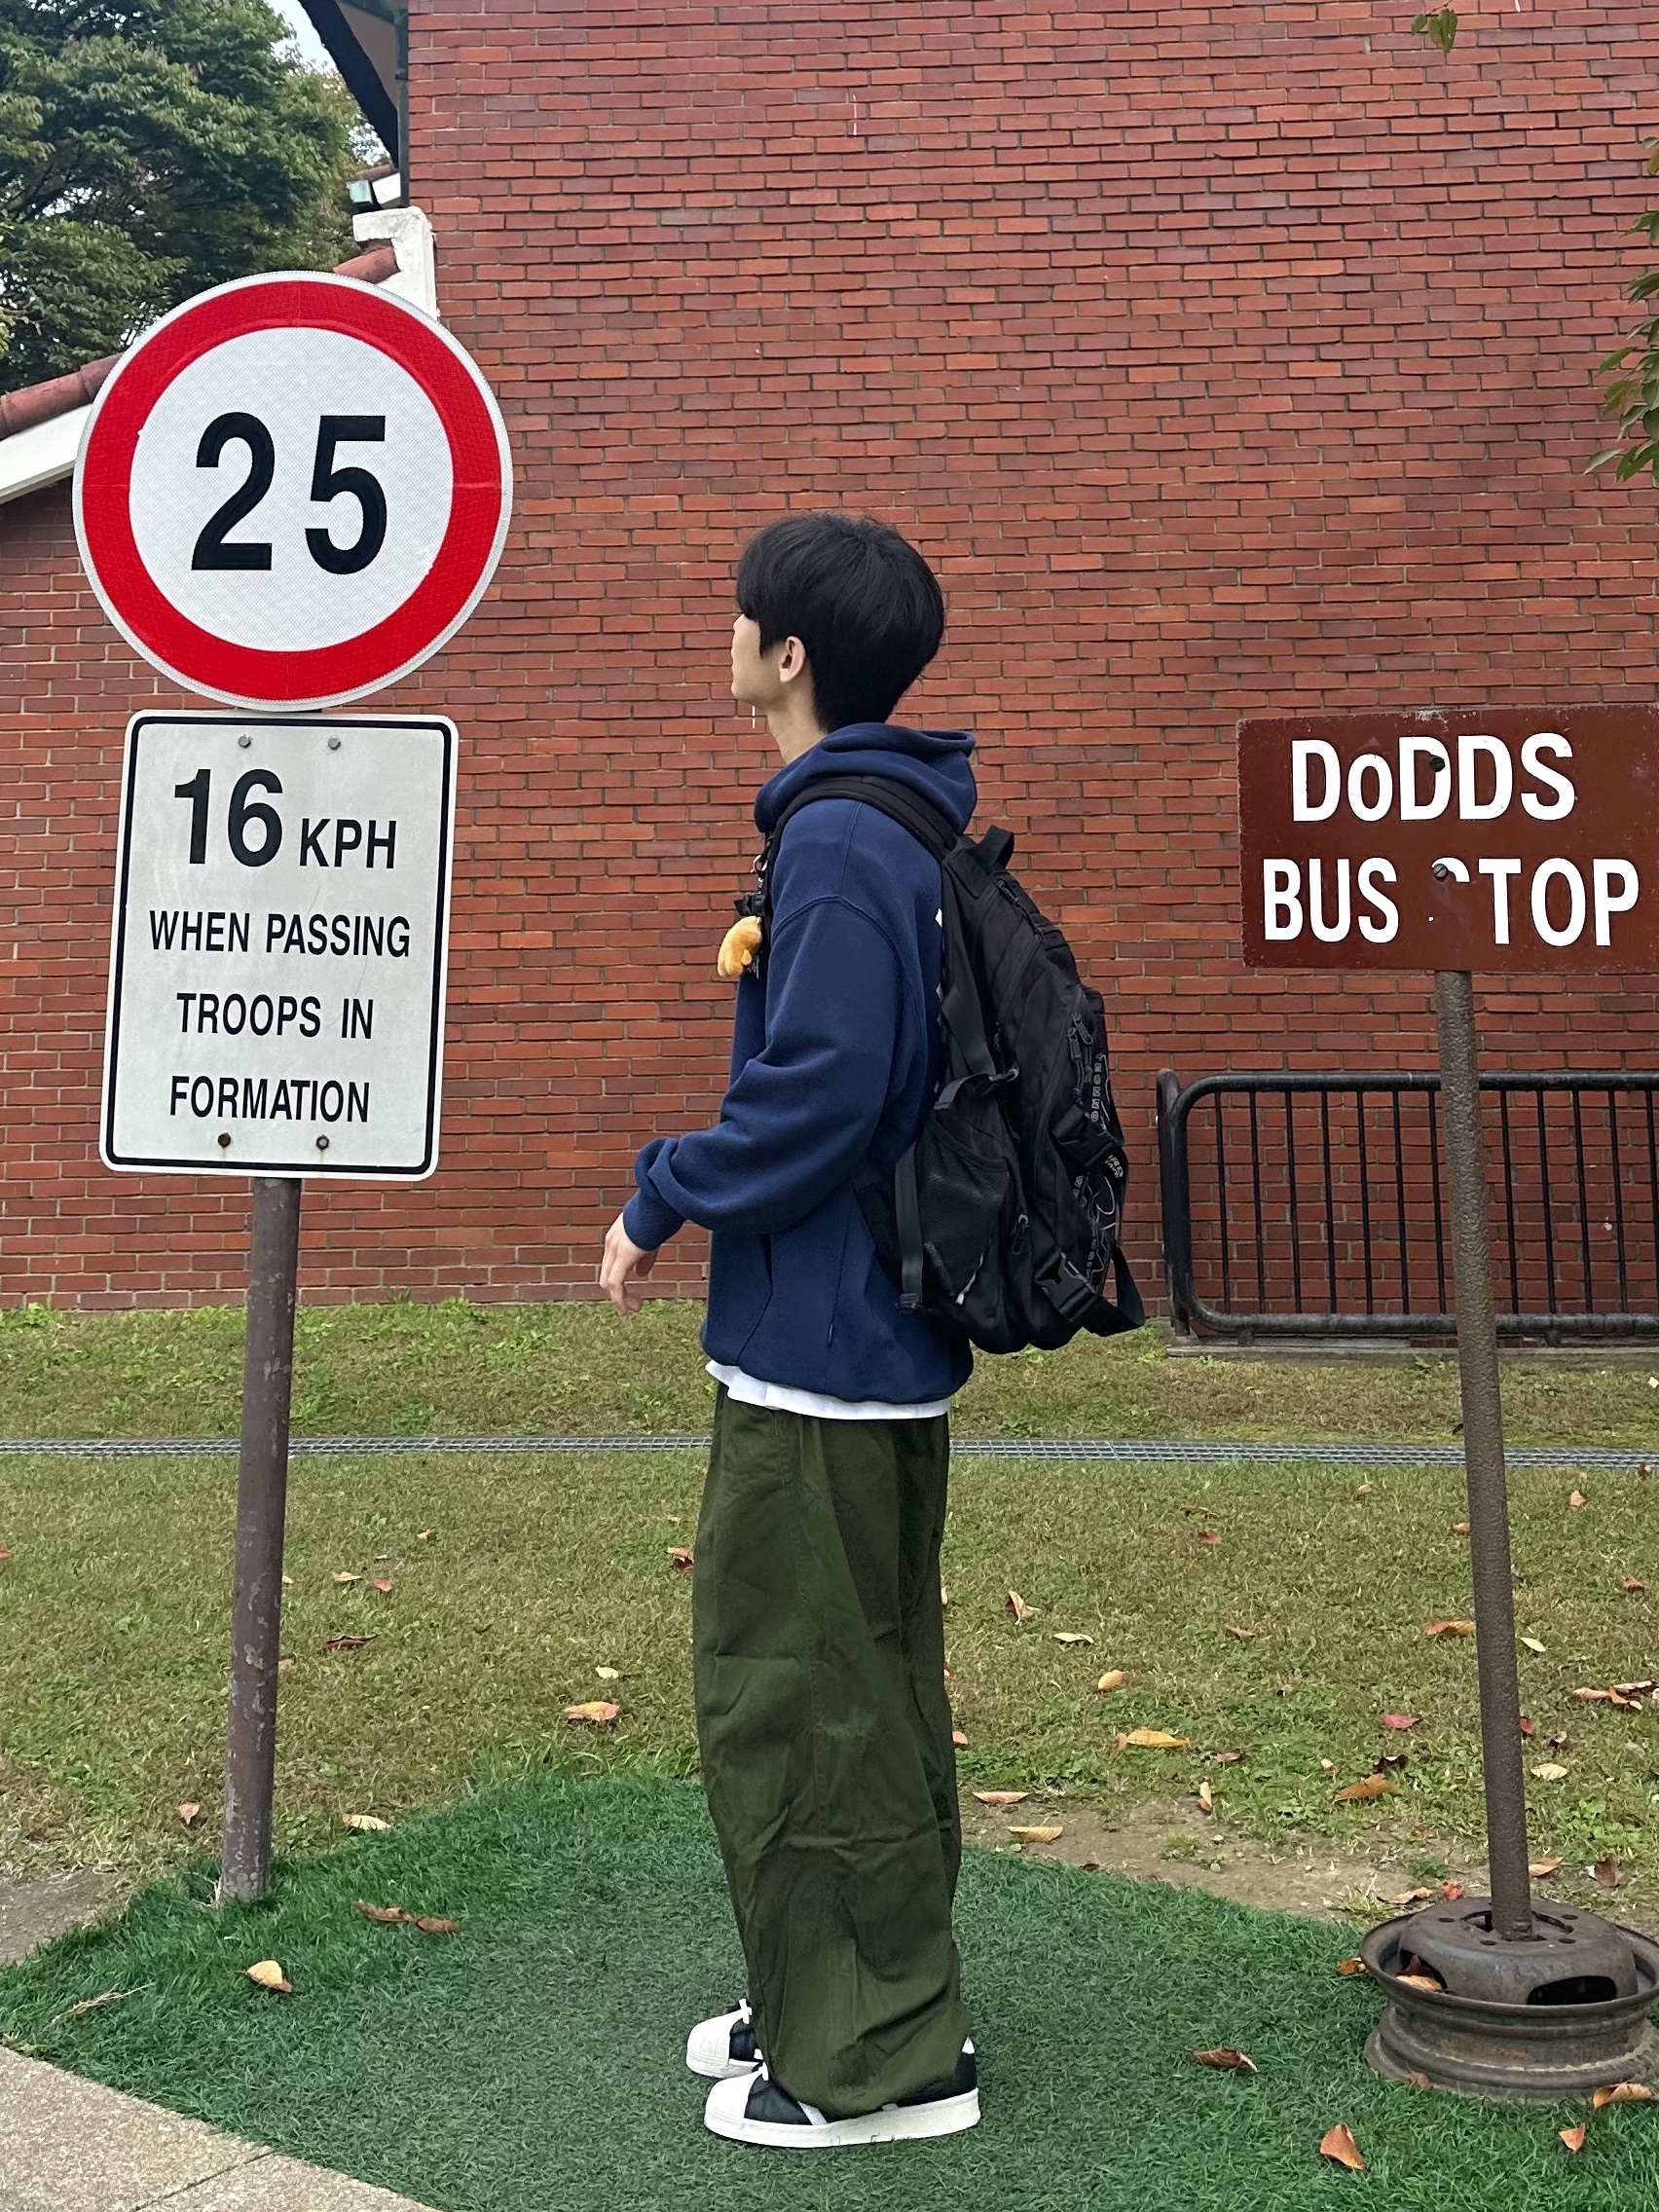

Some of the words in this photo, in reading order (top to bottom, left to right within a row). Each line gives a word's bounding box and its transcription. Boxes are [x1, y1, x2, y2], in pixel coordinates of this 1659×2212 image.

[192, 412, 387, 574] 25
[174, 769, 282, 866] 16
[300, 819, 396, 868] KPH
[1292, 733, 1574, 821] DoDDS
[150, 910, 249, 952] WHEN
[267, 914, 409, 957] PASSING
[1264, 858, 1398, 942] BUS
[177, 993, 320, 1037] TROOPS
[342, 999, 373, 1039] IN
[170, 1076, 369, 1122] FORMATION
